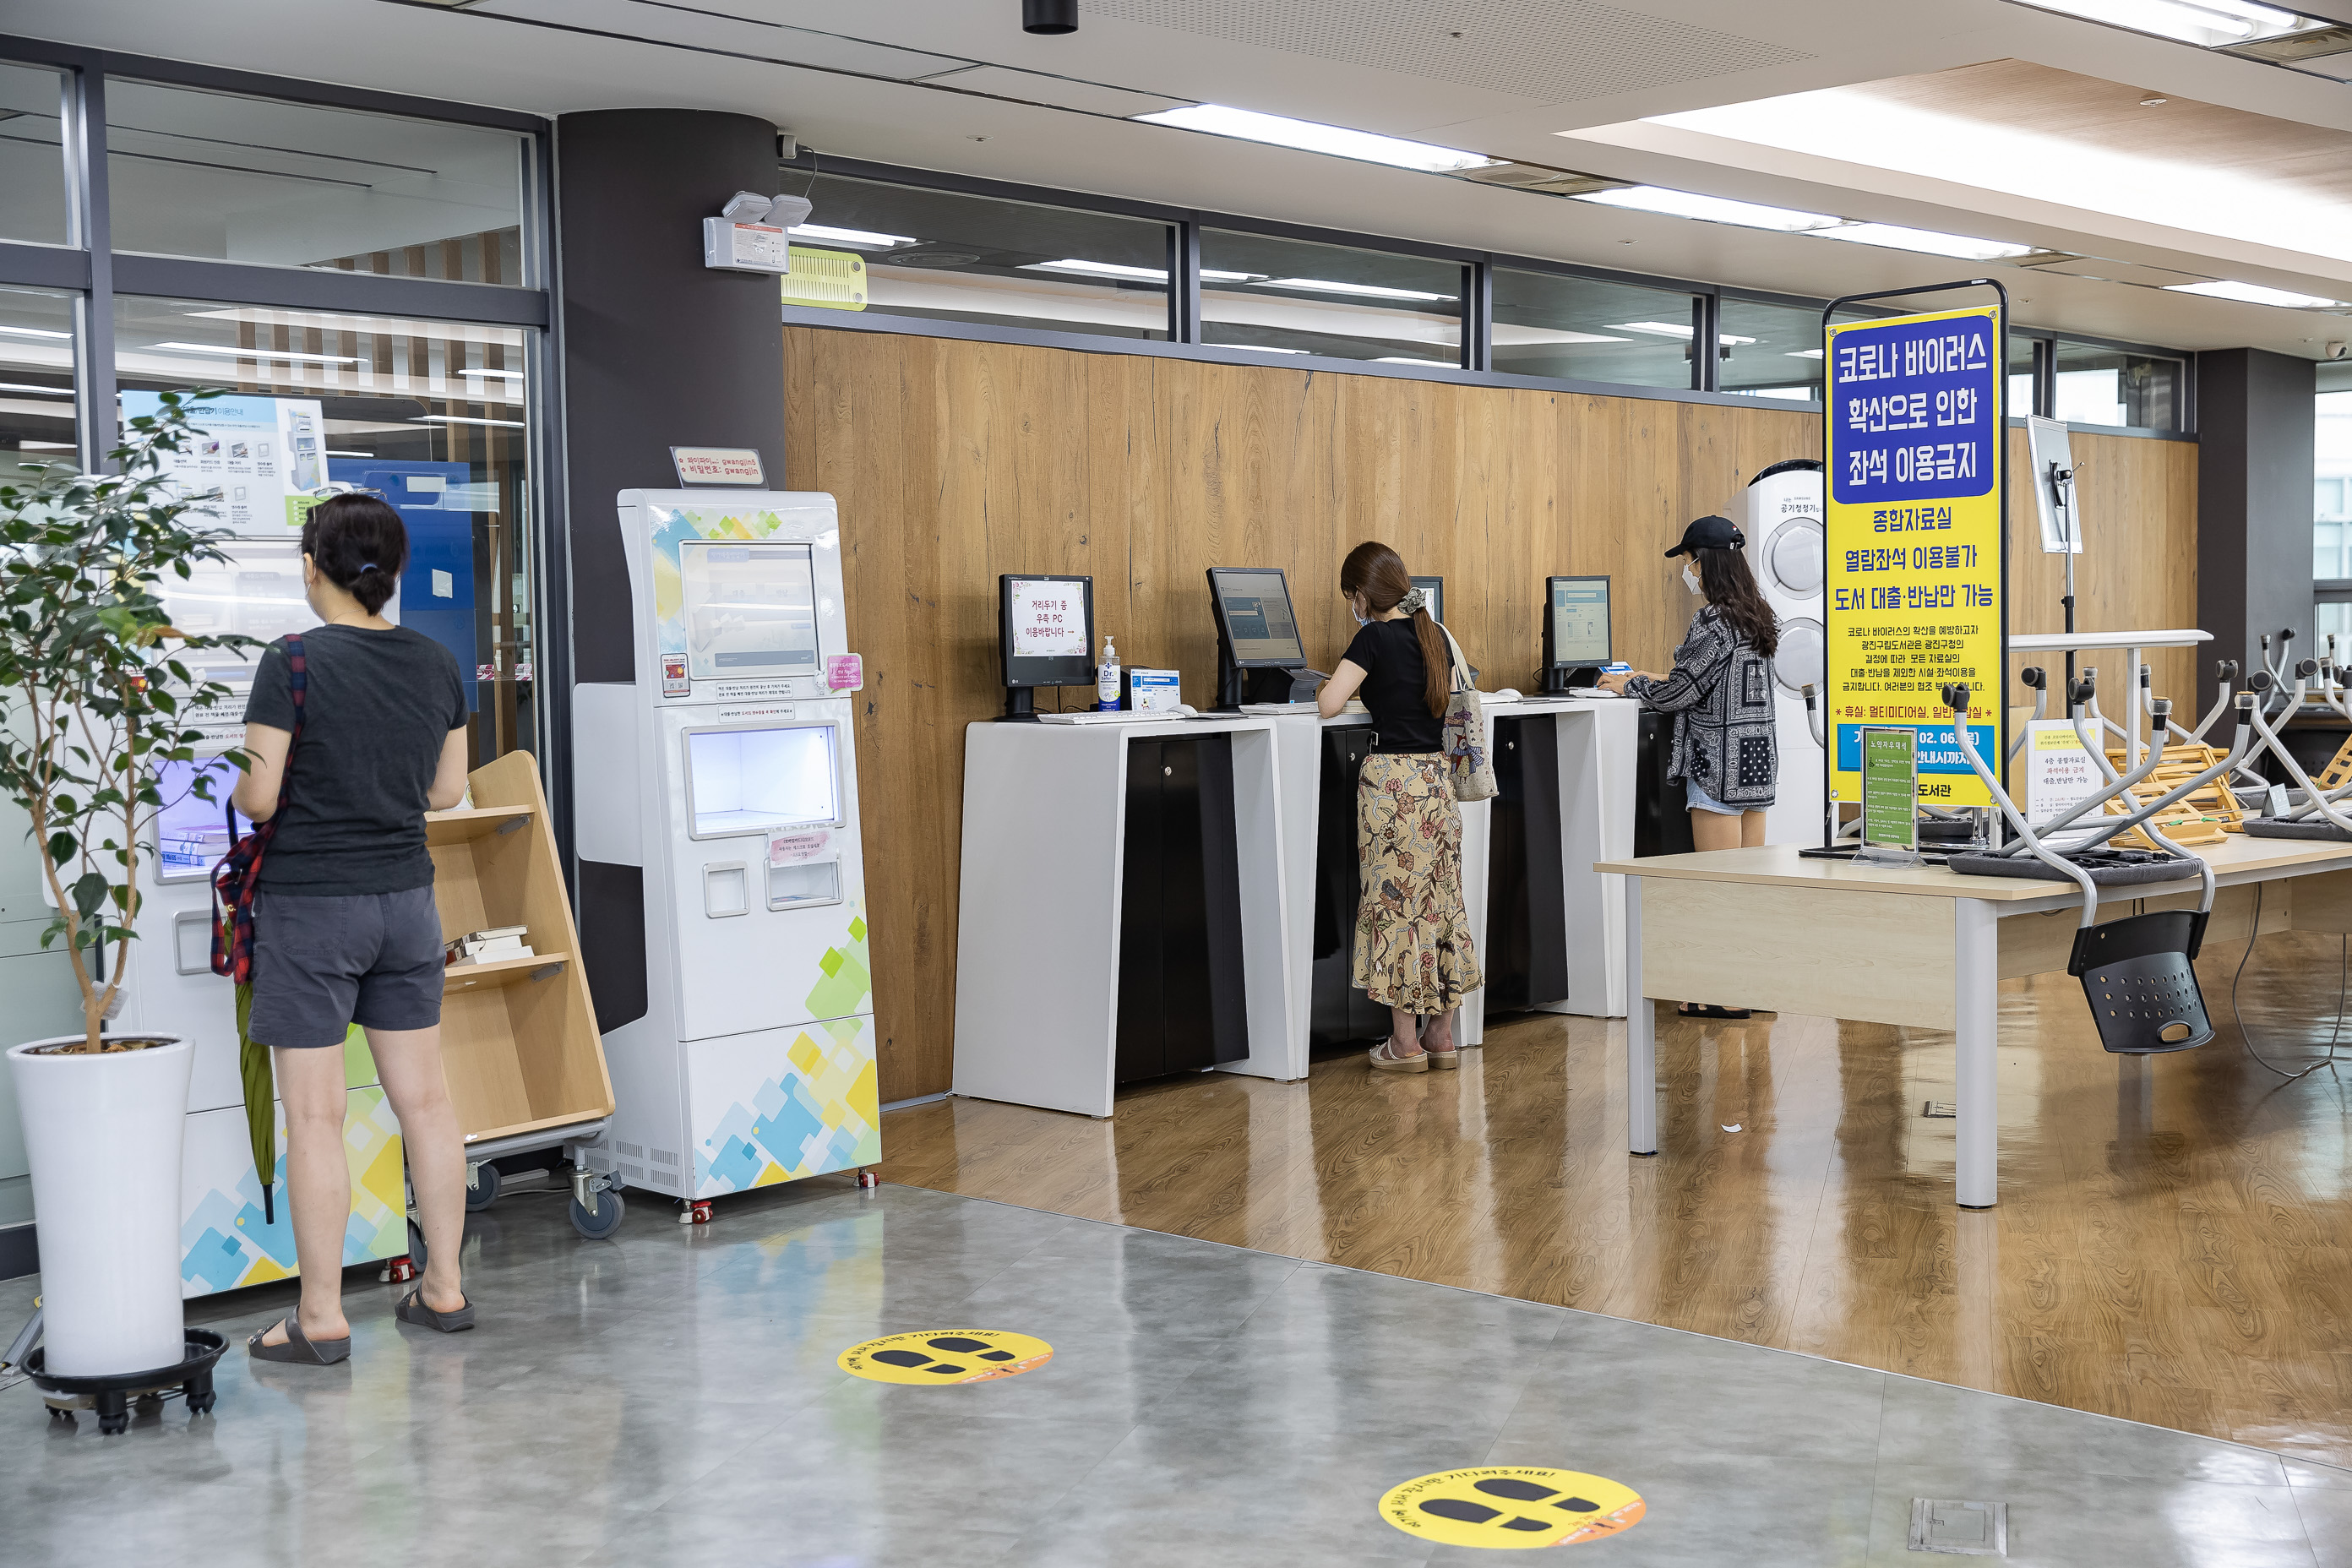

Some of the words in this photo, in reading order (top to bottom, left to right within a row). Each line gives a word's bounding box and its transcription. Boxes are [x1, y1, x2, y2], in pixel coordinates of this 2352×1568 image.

[1839, 342, 1897, 384] 코로나
[1905, 333, 1987, 377] 바이러스
[1848, 392, 1929, 433] 확산으로
[1936, 387, 1978, 427] 인한
[1848, 449, 1888, 486] 좌석
[1896, 442, 1977, 482] 이용금지
[724, 467, 759, 476] gwangjin
[1873, 507, 1952, 533] 종합자료실
[1845, 548, 1907, 572] 열람좌석
[1913, 544, 1977, 569] 이용불가
[1835, 588, 1865, 611] 도서
[1871, 585, 1955, 610] 대출·반납만
[1962, 584, 1993, 607] 가능
[1032, 600, 1057, 611] 거리두기
[1060, 601, 1067, 611] 중
[1037, 614, 1049, 623] 우측
[1053, 614, 1063, 623] PC
[1848, 627, 1870, 637] 코로나
[1872, 627, 1910, 636] 바이러스의
[1913, 626, 1936, 635] 확산을
[1939, 625, 1979, 635] 예방하고자
[1861, 640, 1922, 651] 광진구립도서관은
[1925, 640, 1964, 650] 광진구청의
[1865, 654, 1888, 664] 결정에
[1891, 654, 1906, 664] 따라
[1911, 654, 1926, 664] 모든
[1929, 654, 1960, 663] 자료실의
[1892, 667, 1916, 678] 제외한
[1843, 682, 1882, 692] 금지합니다.
[1884, 682, 1914, 691] 여러분의
[1918, 682, 1932, 692] 협조
[1845, 705, 1866, 718] 휴실:
[1869, 705, 1930, 719] 멀티미디어실,
[1919, 732, 1937, 744] 02.
[1870, 740, 1907, 751] 노약자우대석
[1402, 1478, 1446, 1493] 잠시만
